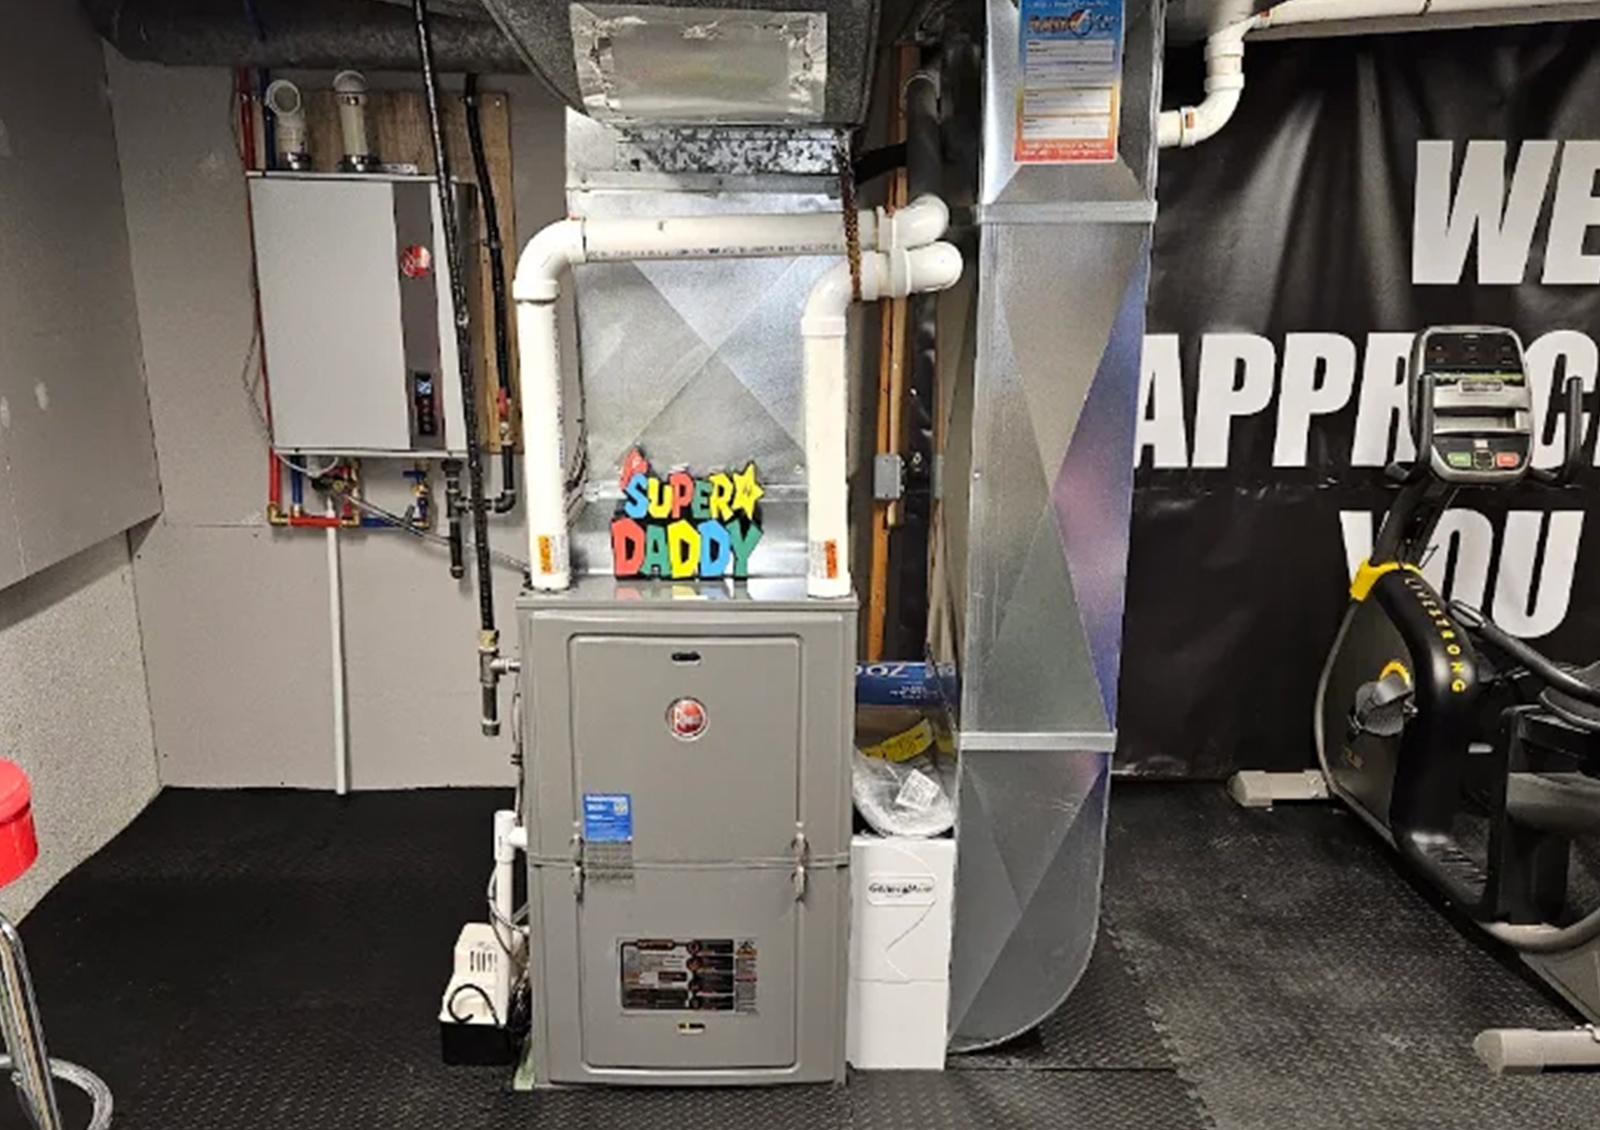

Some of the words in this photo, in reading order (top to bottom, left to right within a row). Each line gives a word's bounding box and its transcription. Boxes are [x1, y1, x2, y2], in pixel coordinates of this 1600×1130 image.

[1412, 140, 1600, 285] WE
[623, 471, 735, 522] SUPER
[610, 518, 764, 579] DADDY
